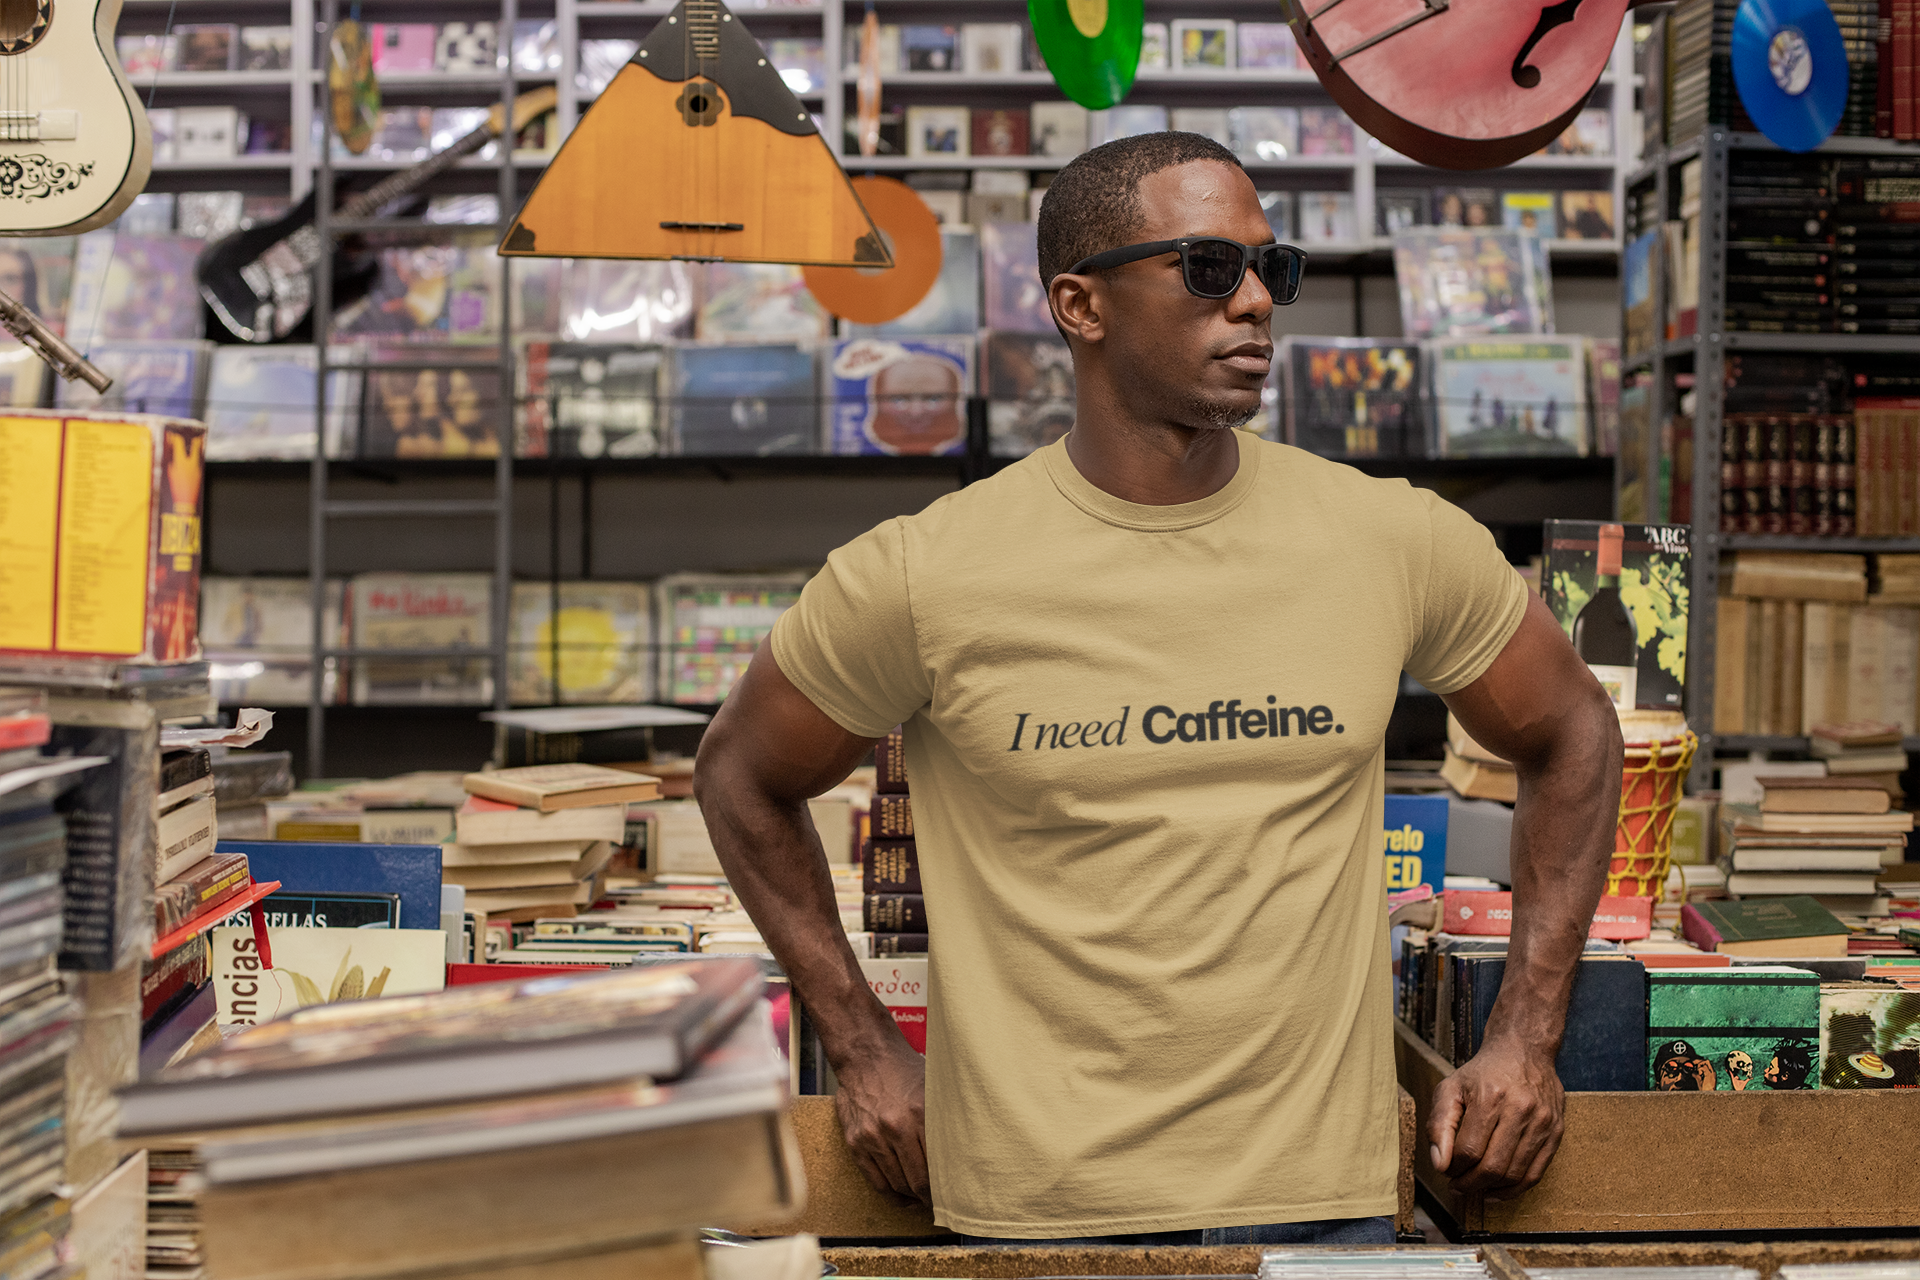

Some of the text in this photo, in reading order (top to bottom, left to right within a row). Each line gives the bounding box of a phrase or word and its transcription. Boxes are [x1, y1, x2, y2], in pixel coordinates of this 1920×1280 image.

[1648, 527, 1686, 544] ABC
[1008, 695, 1345, 751] I need Caffeine.
[225, 911, 328, 928] ESRELLAS
[223, 938, 259, 1025] ncias
